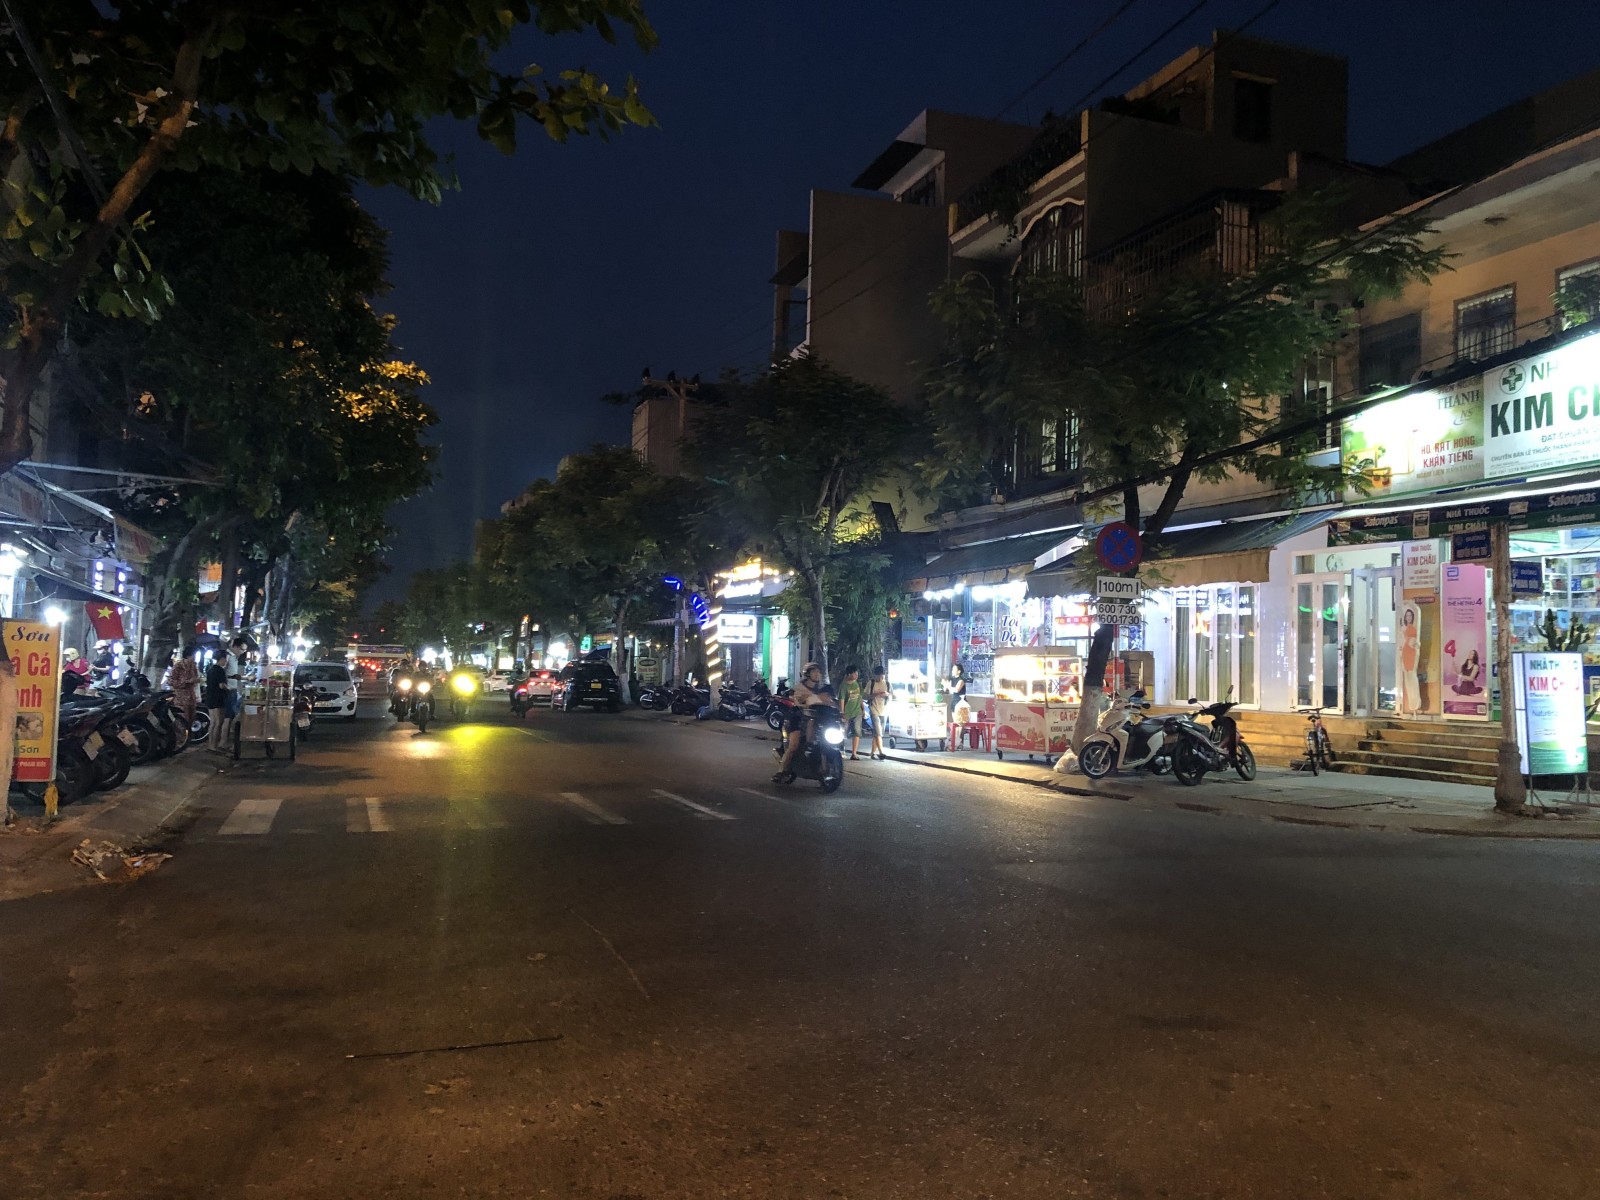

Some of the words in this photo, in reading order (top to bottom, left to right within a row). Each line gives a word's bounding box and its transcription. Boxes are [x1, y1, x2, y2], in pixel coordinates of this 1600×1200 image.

[1491, 391, 1553, 438] KIM
[1547, 492, 1597, 508] Salonpas
[1464, 504, 1491, 516] THUỐC
[1364, 516, 1399, 528] Salonpas
[1448, 522, 1464, 532] KIM
[1419, 553, 1436, 566] CHÂU
[1103, 581, 1133, 593] 100m
[11, 626, 50, 642] Sơn
[27, 652, 51, 677] Cá
[1530, 658, 1548, 670] NHÀ
[1529, 676, 1548, 691] KIM
